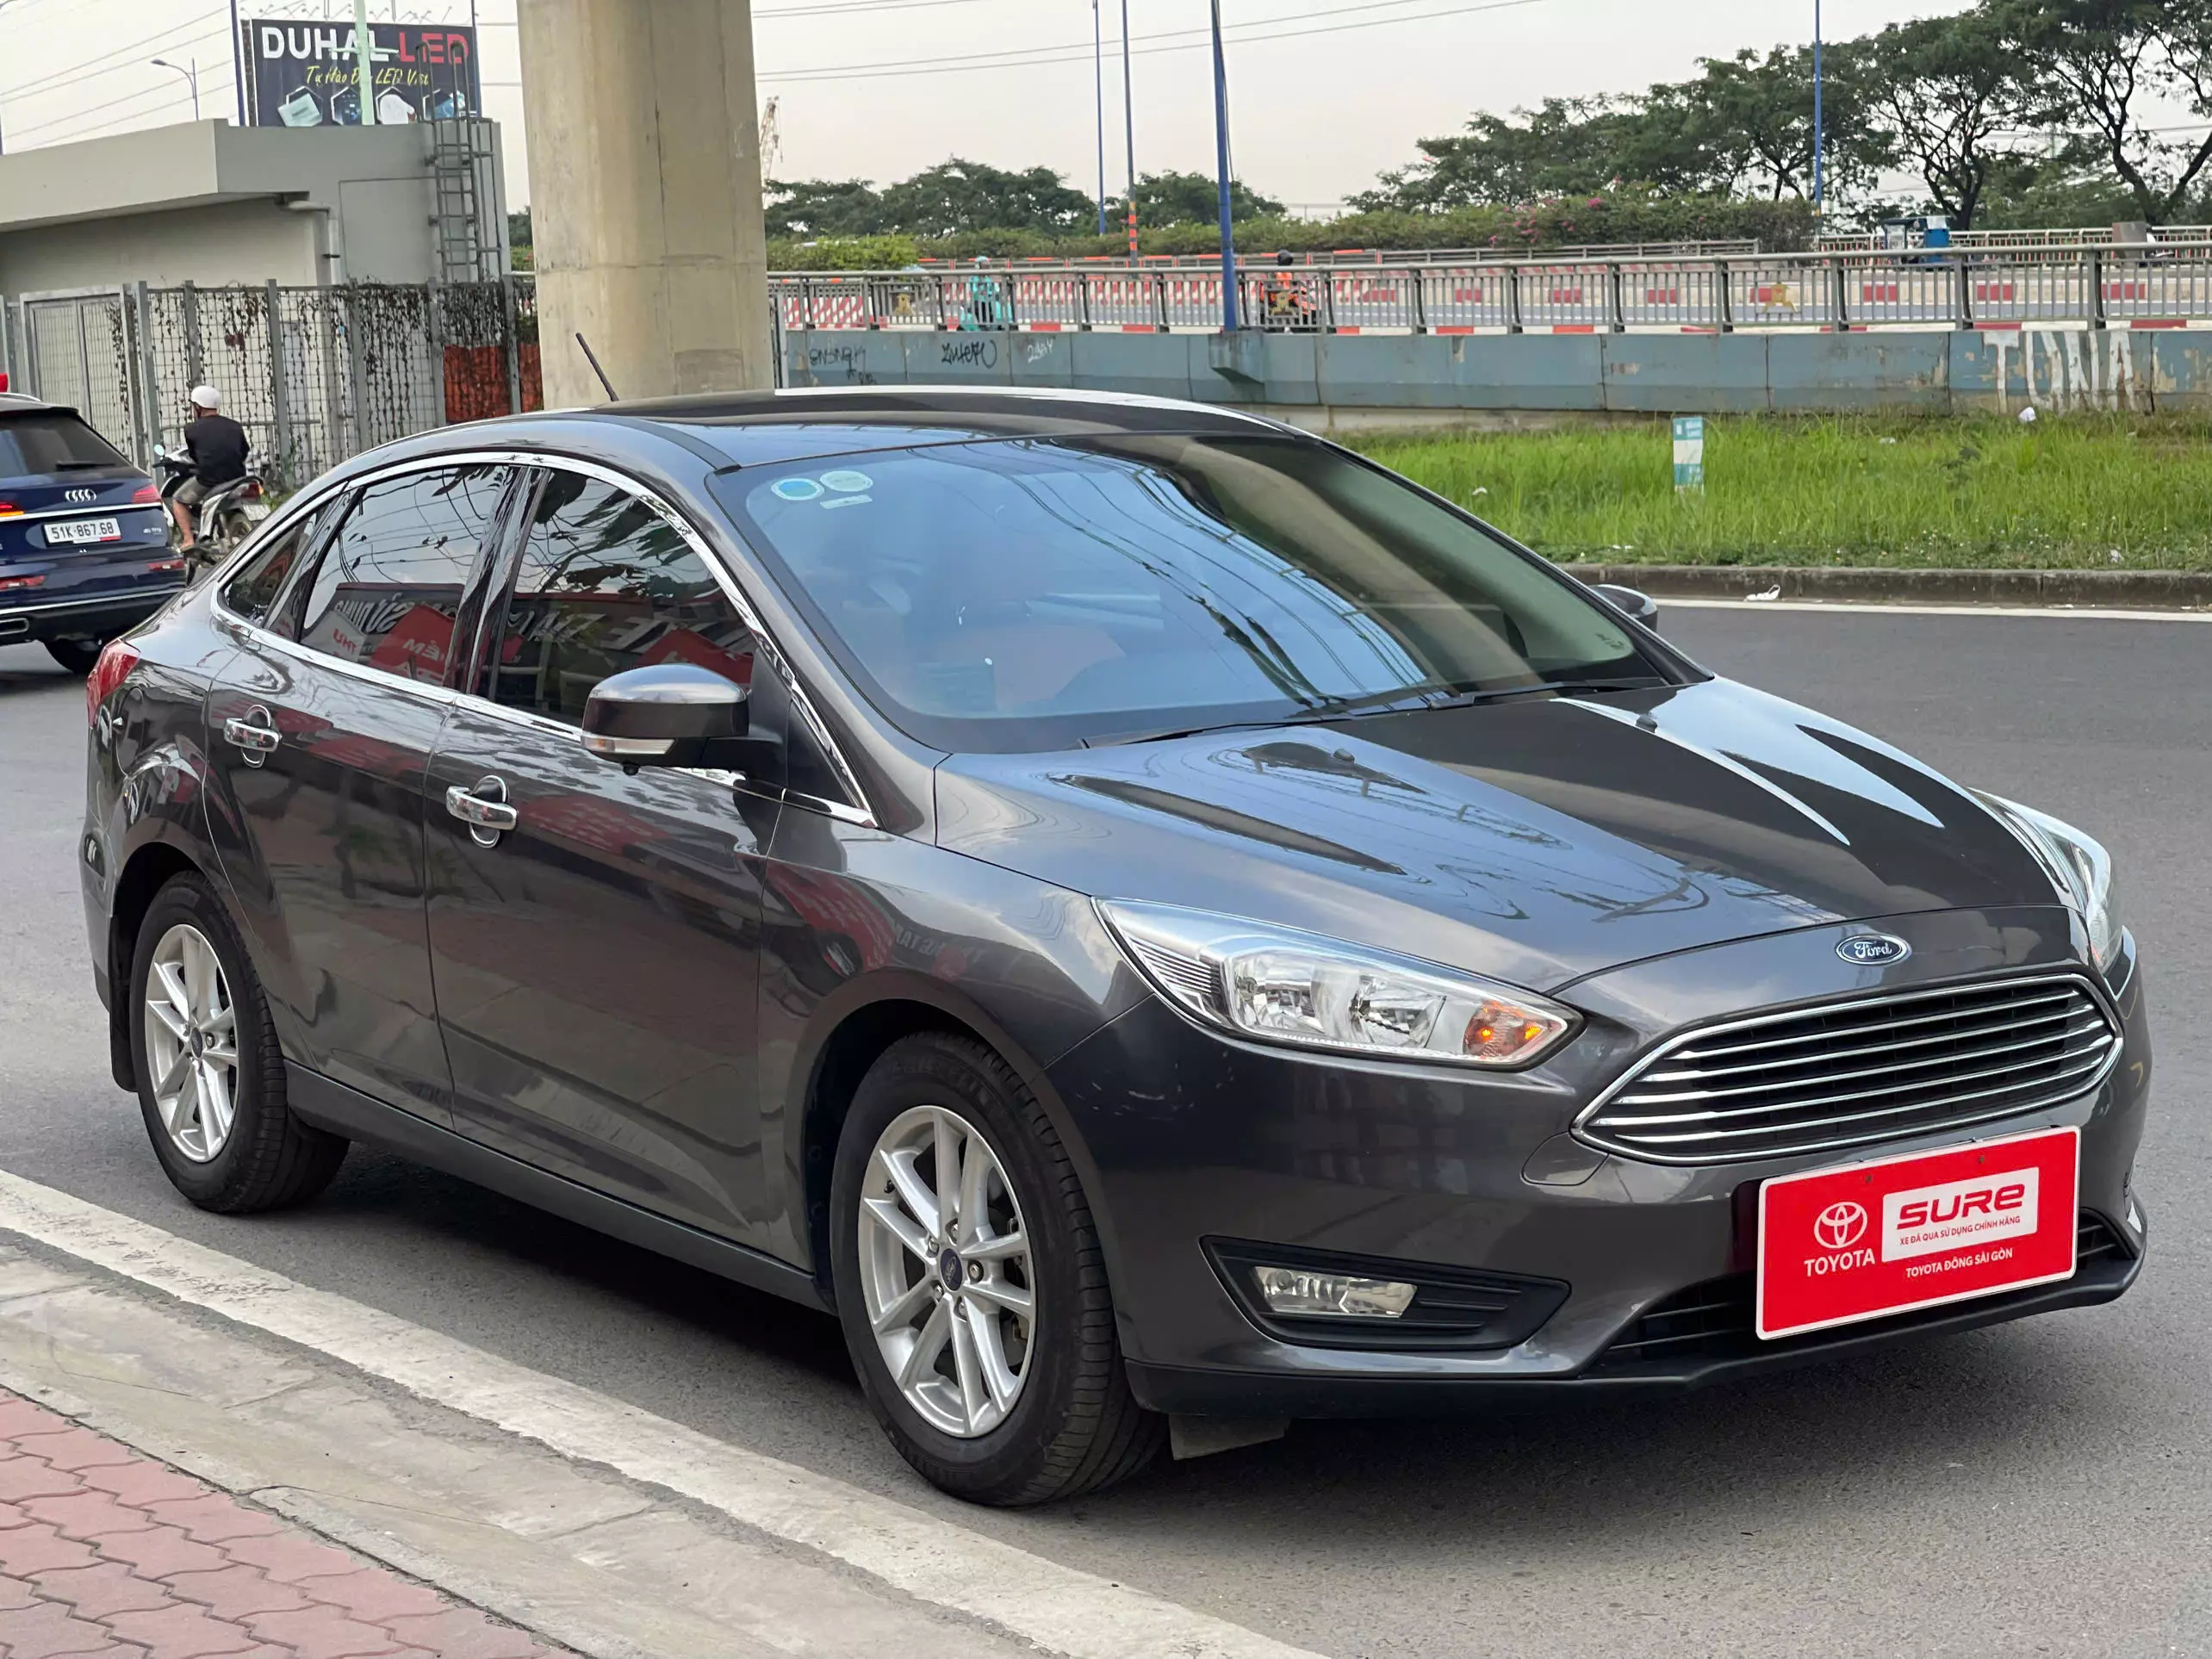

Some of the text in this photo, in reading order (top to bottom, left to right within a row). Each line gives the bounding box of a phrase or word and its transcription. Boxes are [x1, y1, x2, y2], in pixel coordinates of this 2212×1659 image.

[261, 27, 469, 64] DUHAL LED
[1854, 941, 1892, 958] Ford
[1900, 1236, 1910, 1246] XE
[1922, 1231, 1939, 1241] QUA
[1940, 1227, 1951, 1238] SỬ
[1951, 1224, 1973, 1236] DỤNG
[1974, 1219, 1998, 1231] CHÍNH
[1998, 1215, 2021, 1227] HÃNG
[1804, 1248, 1875, 1277] TOYOTA
[1905, 1246, 2013, 1278] TOYOTA ĐÔNG SÀI GÒN
